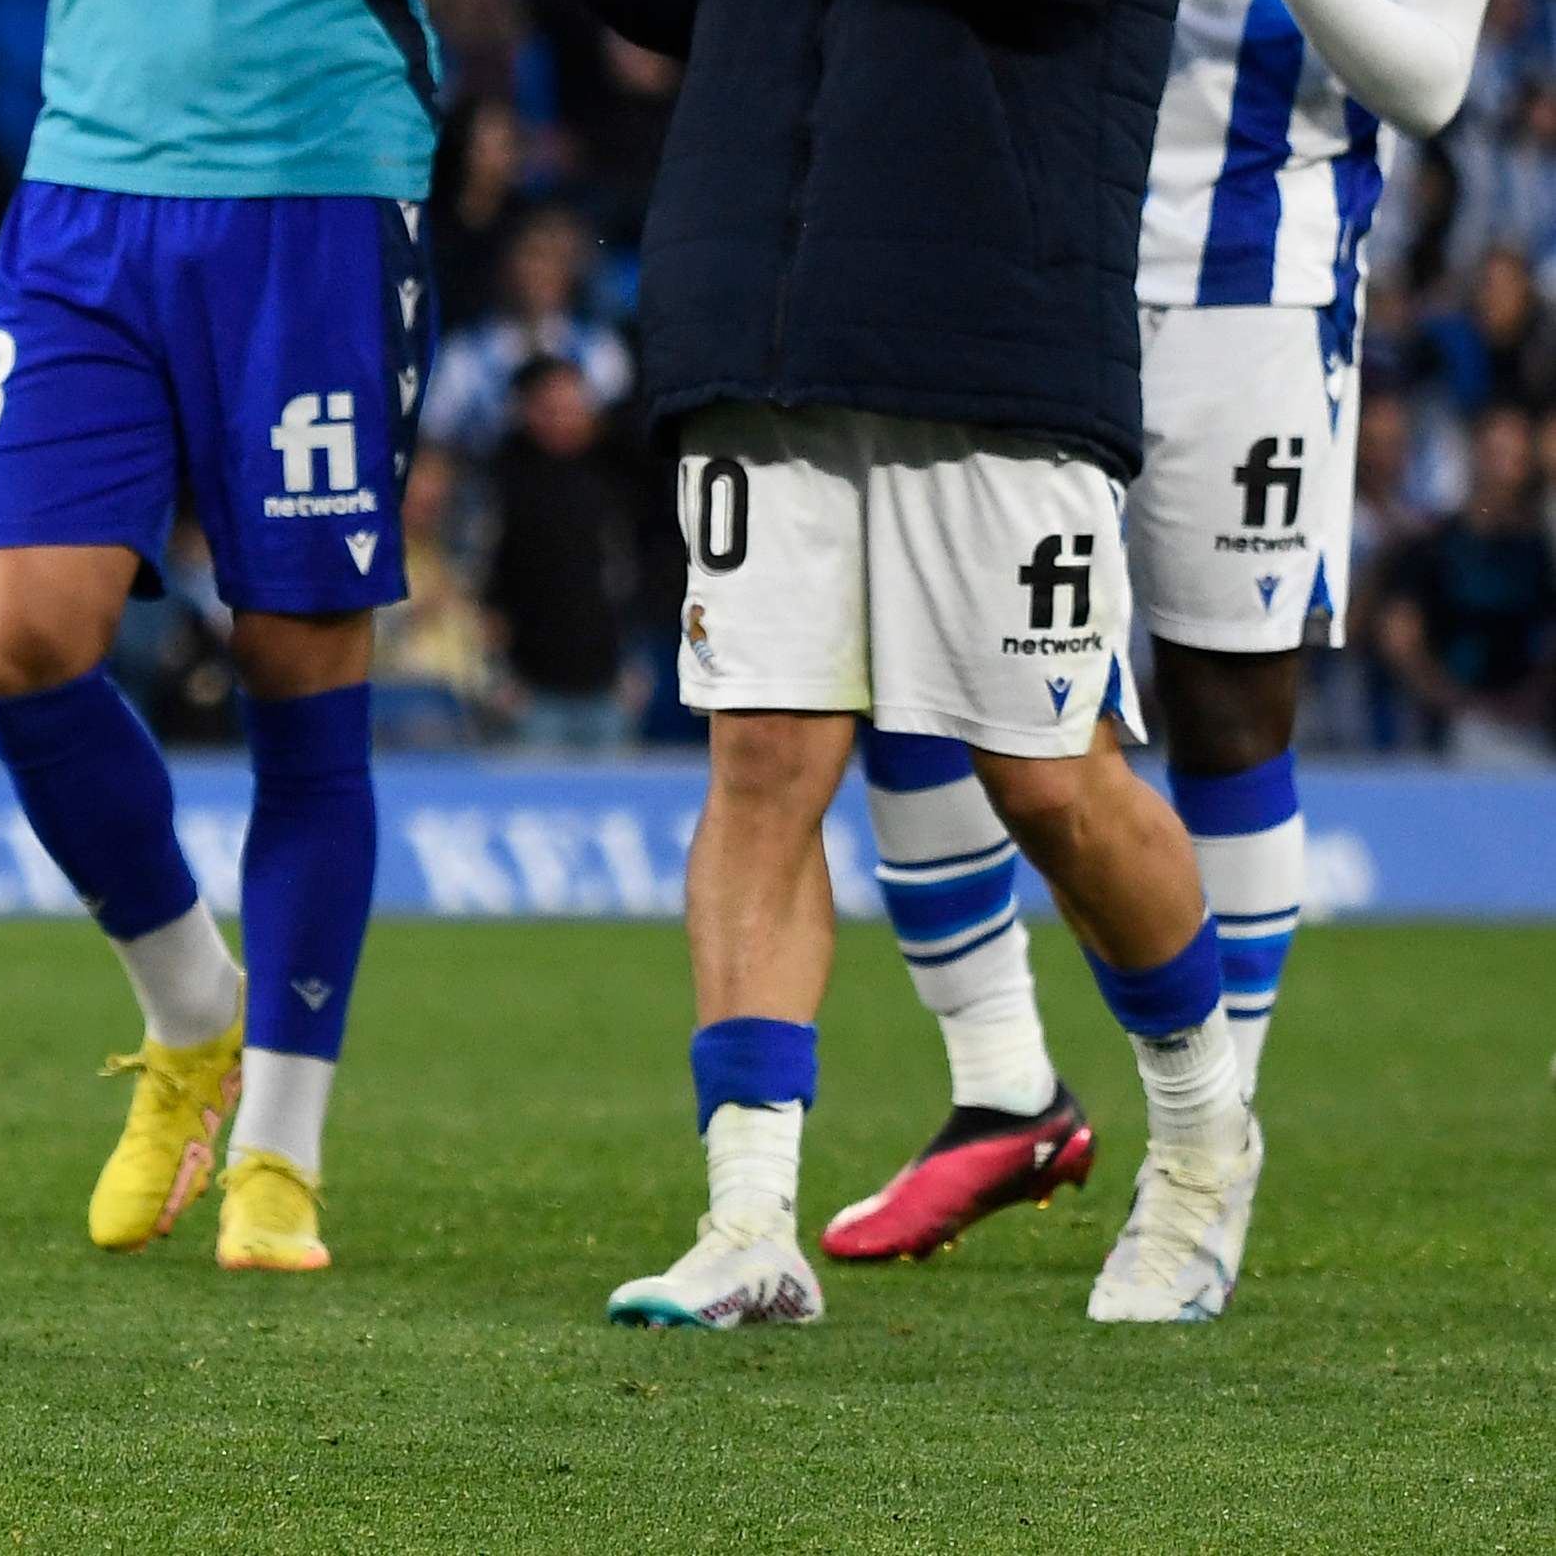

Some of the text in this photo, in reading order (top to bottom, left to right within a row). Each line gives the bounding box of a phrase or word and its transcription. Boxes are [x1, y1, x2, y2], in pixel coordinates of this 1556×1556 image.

[270, 390, 357, 493] fi
[1232, 437, 1304, 527] fi
[263, 486, 378, 519] network
[682, 457, 749, 576] 0
[1018, 534, 1094, 629] fi
[1002, 632, 1103, 655] network
